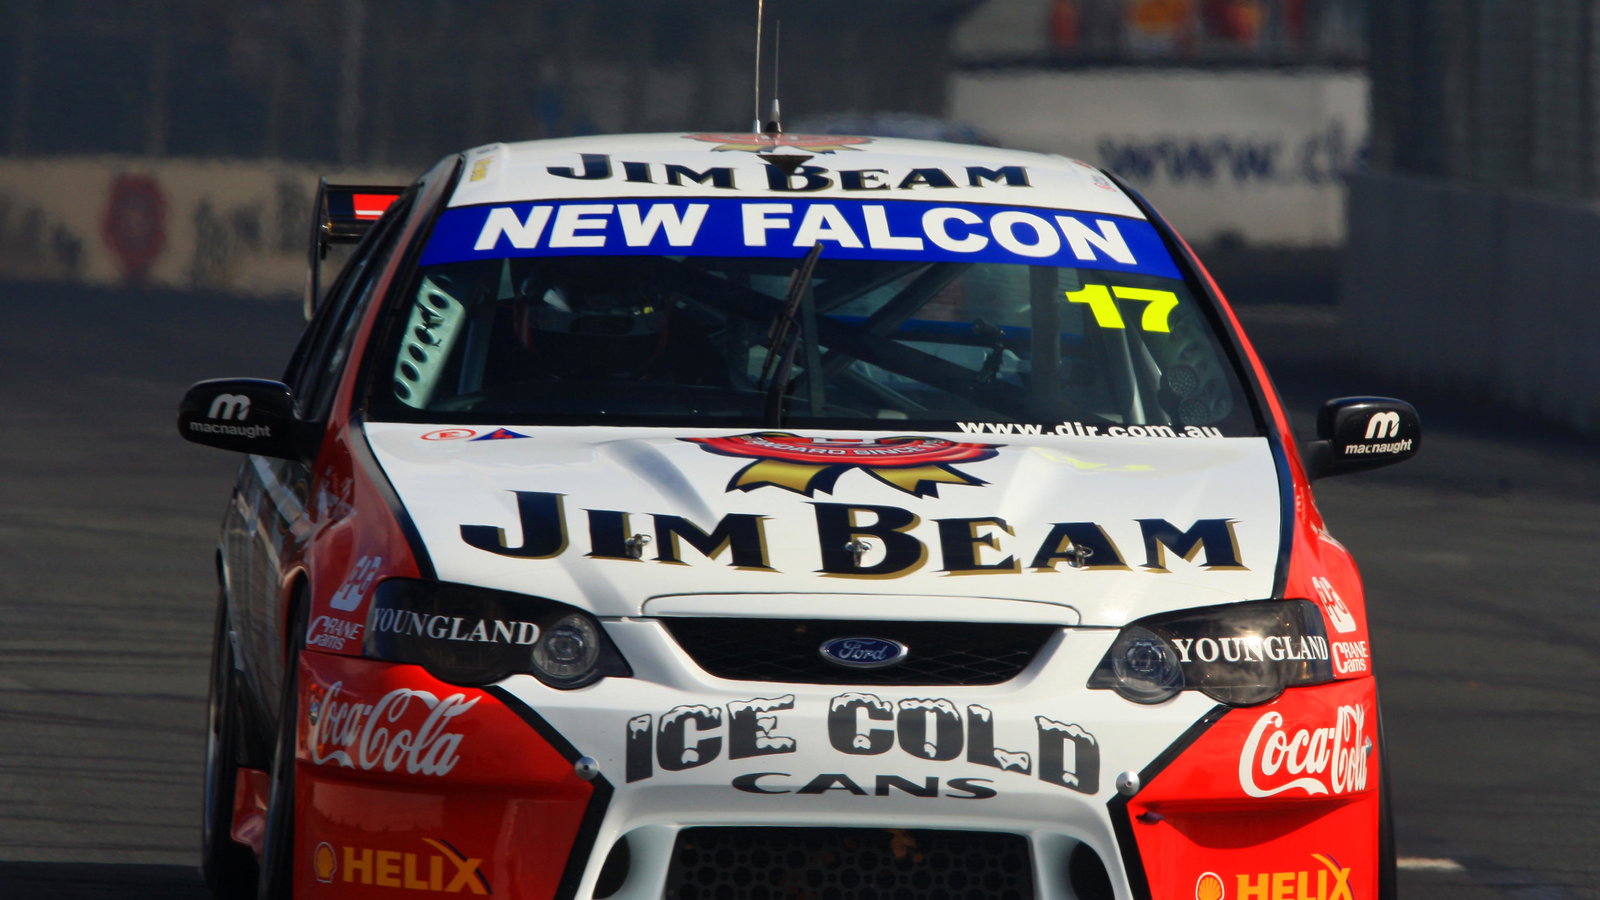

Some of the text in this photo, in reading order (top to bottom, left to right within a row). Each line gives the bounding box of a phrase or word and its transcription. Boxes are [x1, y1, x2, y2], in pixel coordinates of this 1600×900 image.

[547, 153, 1033, 192] JIM BEAM
[474, 203, 1137, 265] NEW FALCON
[1065, 283, 1180, 333] 17
[189, 421, 272, 439] macnaught
[741, 435, 847, 455] ANDARD
[1345, 438, 1413, 455] macnaught
[459, 490, 1252, 580] JIM BEAM
[370, 607, 541, 645] YOUNGLAND
[838, 640, 890, 660] Ford
[1172, 635, 1329, 662] YOUNGLAND
[307, 681, 482, 776] Coca-Cola
[626, 692, 1100, 795] ICE COLD
[1239, 704, 1368, 798] Coca-Cola
[732, 772, 998, 799] CANS
[342, 838, 492, 895] HELIX
[1236, 853, 1355, 900] HELIX
